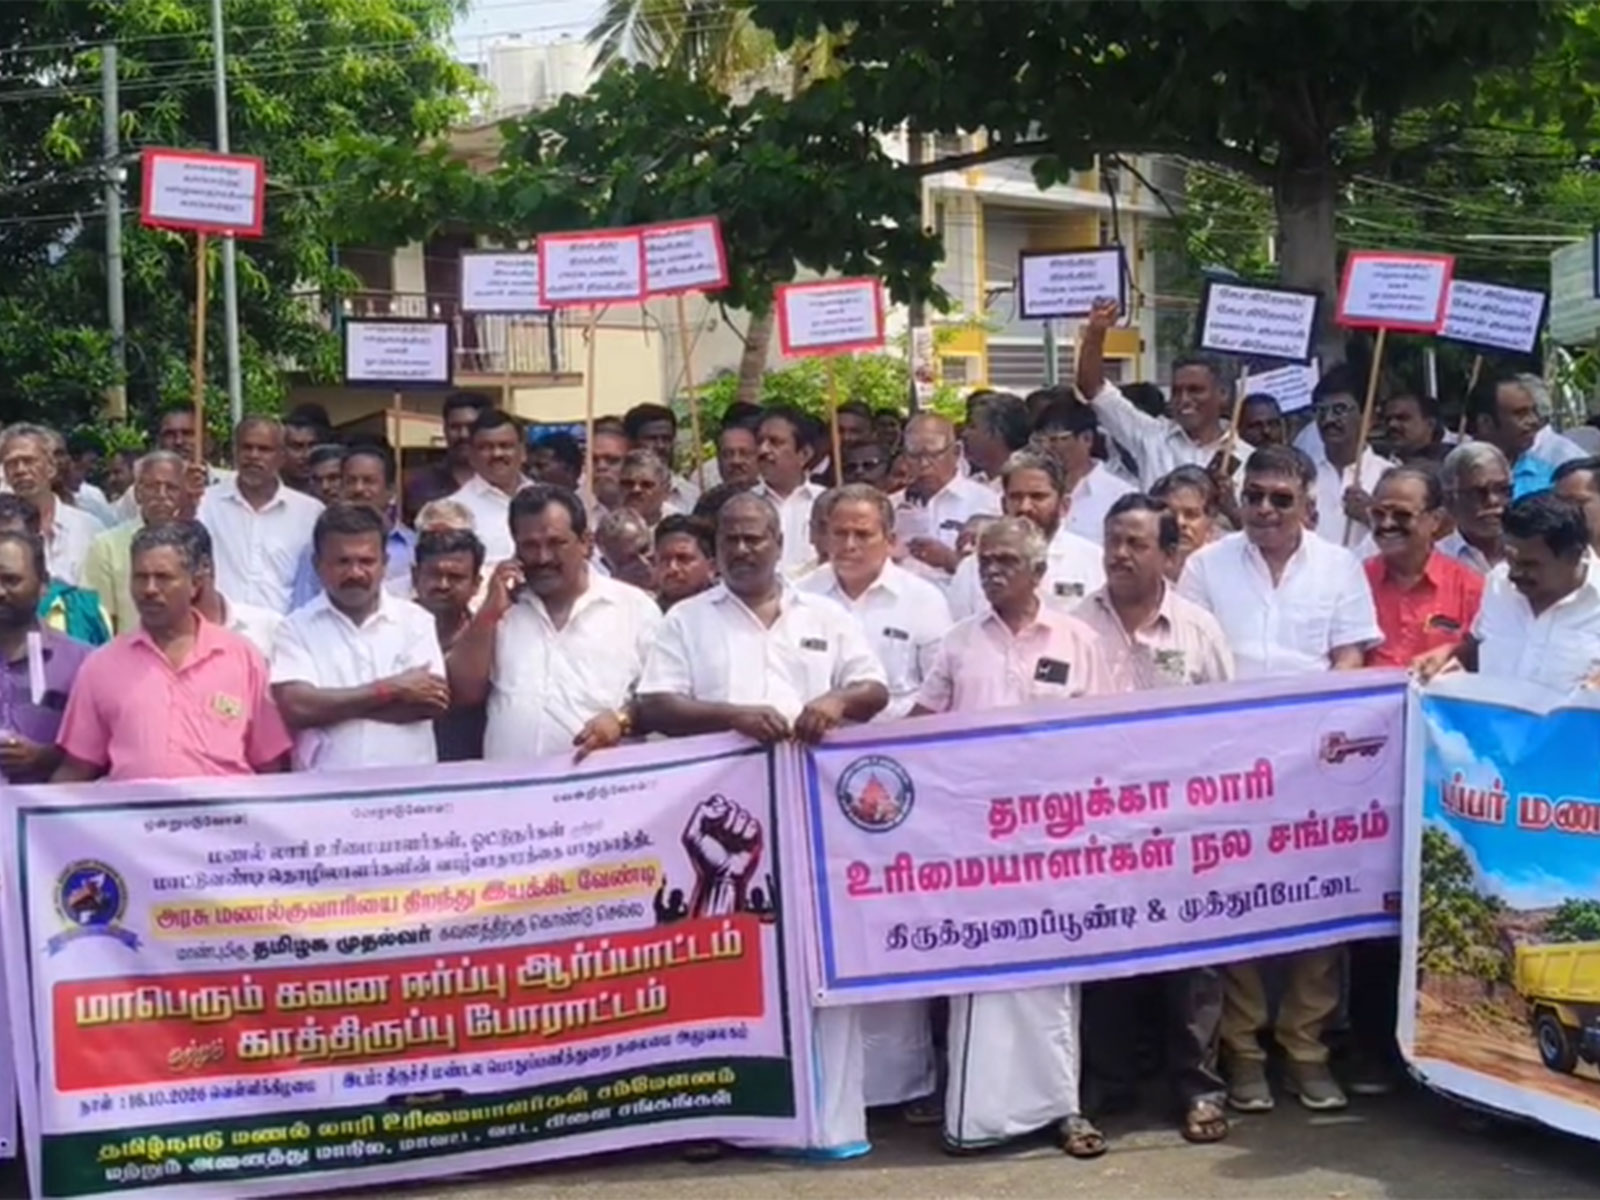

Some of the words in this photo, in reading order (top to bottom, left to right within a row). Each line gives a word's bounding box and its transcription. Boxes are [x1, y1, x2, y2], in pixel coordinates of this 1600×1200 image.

[988, 777, 1170, 839] தாலுக்கா
[1186, 757, 1274, 805] லாரி
[846, 828, 1175, 898] உரிமையாளர்கள்
[1191, 825, 1251, 875] நல
[1267, 800, 1390, 852] சங்கம்
[157, 907, 209, 929] அரசு
[577, 864, 655, 891] வேண்டி
[253, 934, 329, 961] தமிழக
[336, 924, 432, 954] முதல்வர்
[530, 906, 593, 932] கொண்டு
[597, 900, 645, 922] செல்ல
[885, 904, 1138, 951] திருத்துறைப்பூண்டி
[1148, 899, 1167, 923] &
[1179, 874, 1361, 925] முத்துப்பேட்டை
[75, 975, 264, 1025] மாபெரும்
[276, 973, 390, 1009] கவன
[402, 957, 506, 999] ஈர்ப்பு
[517, 919, 743, 989] ஆர்ப்பாட்டம்
[237, 1006, 456, 1060] காத்திருப்பு
[465, 978, 668, 1037] போராட்டம்
[97, 1130, 224, 1160] தமிழ்நாடு
[231, 1121, 311, 1146] மணல்
[318, 1114, 376, 1137] லாரி
[382, 1086, 588, 1132] உரிமையாளர்கள்
[597, 1066, 736, 1099] சம்மேளனம்
[617, 1089, 732, 1118] சங்கங்கள்
